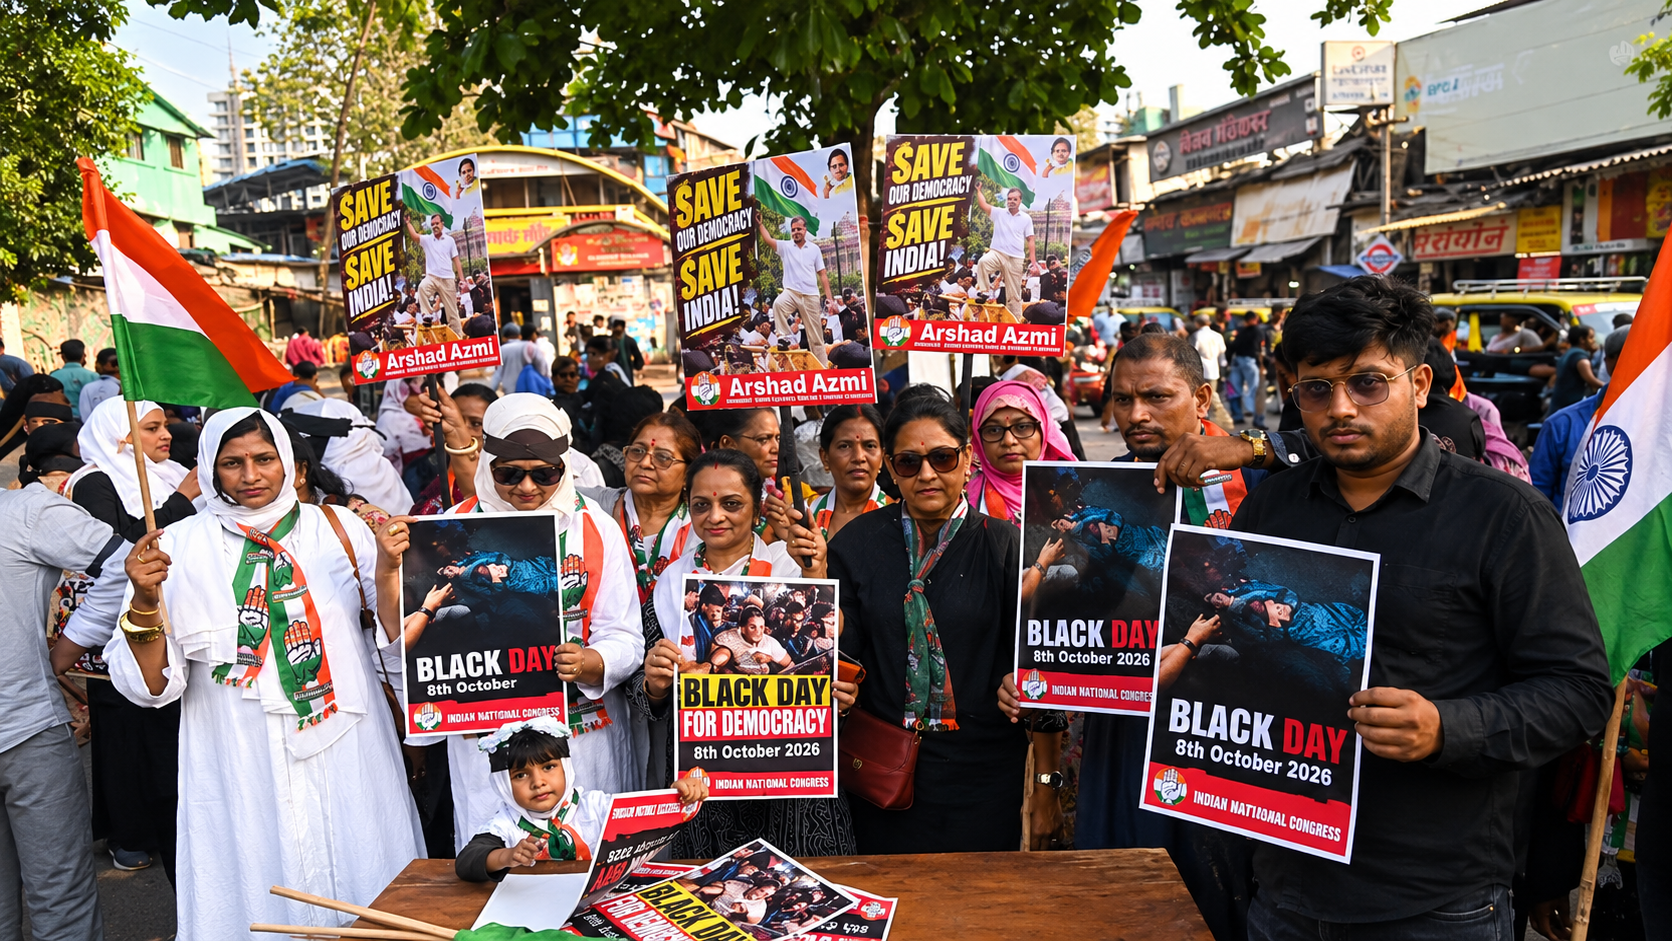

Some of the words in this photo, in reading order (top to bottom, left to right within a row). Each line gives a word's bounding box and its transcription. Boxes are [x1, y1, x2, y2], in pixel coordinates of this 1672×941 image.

[892, 141, 965, 184] SAVE
[340, 179, 392, 231] SAVE
[675, 169, 742, 229] SAVE
[889, 184, 910, 205] OUR
[912, 175, 973, 202] DEMOCRACY
[341, 229, 357, 251] OUR
[677, 227, 696, 252] OUR
[698, 206, 753, 246] DEMOCRACY
[886, 204, 955, 250] SAVE
[345, 239, 395, 290] SAVE
[680, 242, 743, 300] SAVE
[884, 240, 946, 278] INDIA!
[348, 274, 394, 318] INDIA!
[683, 284, 740, 332] INDIA!
[919, 321, 998, 343] Arshad
[1002, 325, 1057, 346] Azmi
[387, 344, 447, 371] Arshad
[450, 338, 495, 361] Azmi
[729, 373, 806, 397] Arshad
[811, 371, 868, 393] Azmi
[1027, 619, 1105, 648] BLACK
[1111, 620, 1159, 649] DAY
[416, 649, 503, 683] BLACK
[508, 645, 556, 674] DAY
[1033, 650, 1054, 663] 8th
[1058, 650, 1113, 665] October
[1116, 652, 1151, 666] 2026
[427, 683, 452, 697] 8th
[456, 678, 518, 694] October
[684, 677, 769, 708] BLACK
[777, 677, 828, 706] DAY
[1051, 685, 1077, 697] INDIAN
[1120, 690, 1153, 702] CONGRES
[683, 710, 717, 737] FOR
[722, 708, 828, 736] DEMOCRACY
[1168, 697, 1275, 751] BLACK
[1283, 717, 1349, 765] DAY
[693, 746, 718, 760] 8th
[722, 743, 781, 759] October
[785, 742, 820, 757] 2026
[1175, 739, 1204, 760] 8th
[1210, 744, 1283, 775] October
[1286, 760, 1332, 786] 2026
[790, 777, 829, 788] CONGRESS
[1193, 790, 1228, 811] INDIAN
[1289, 815, 1342, 843] CONGRESS
[640, 884, 718, 929] BLACK
